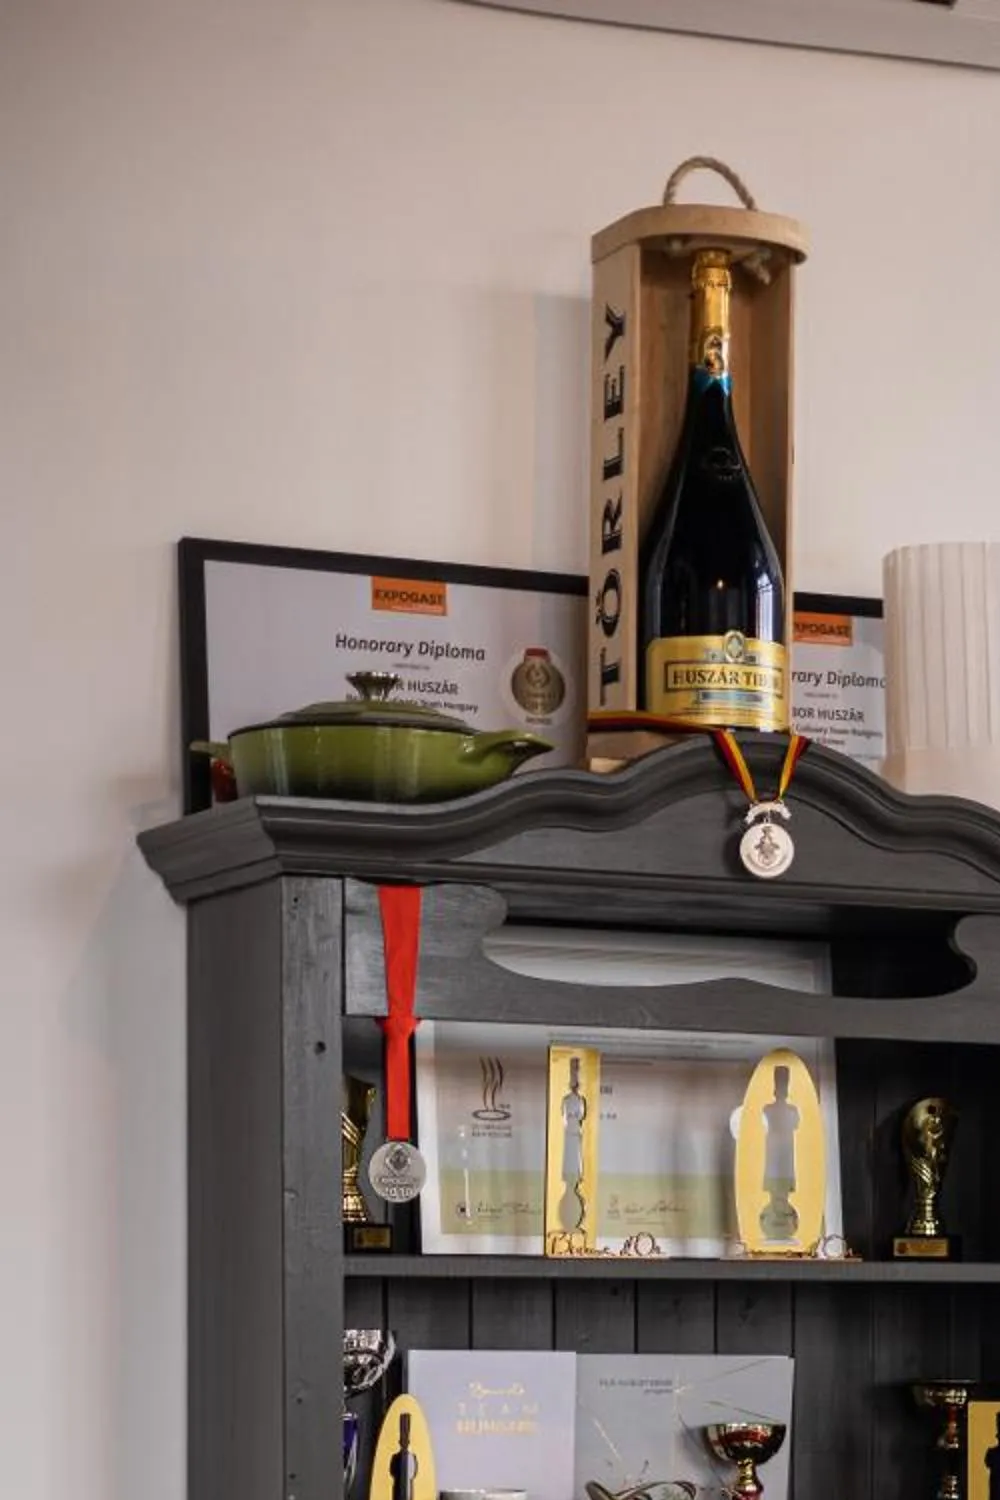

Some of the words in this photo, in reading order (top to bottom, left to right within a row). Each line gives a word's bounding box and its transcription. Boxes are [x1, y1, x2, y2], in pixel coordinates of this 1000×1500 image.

[596, 303, 627, 707] TÖRLEY
[794, 622, 852, 637] XPOGAST
[335, 633, 413, 657] Honorary
[418, 640, 486, 661] Diploma
[673, 667, 739, 685] HUSZÁR
[792, 671, 822, 686] rary
[407, 679, 459, 695] HUSZÁR
[793, 706, 815, 719] BOR
[818, 707, 865, 722] HUSZÁR
